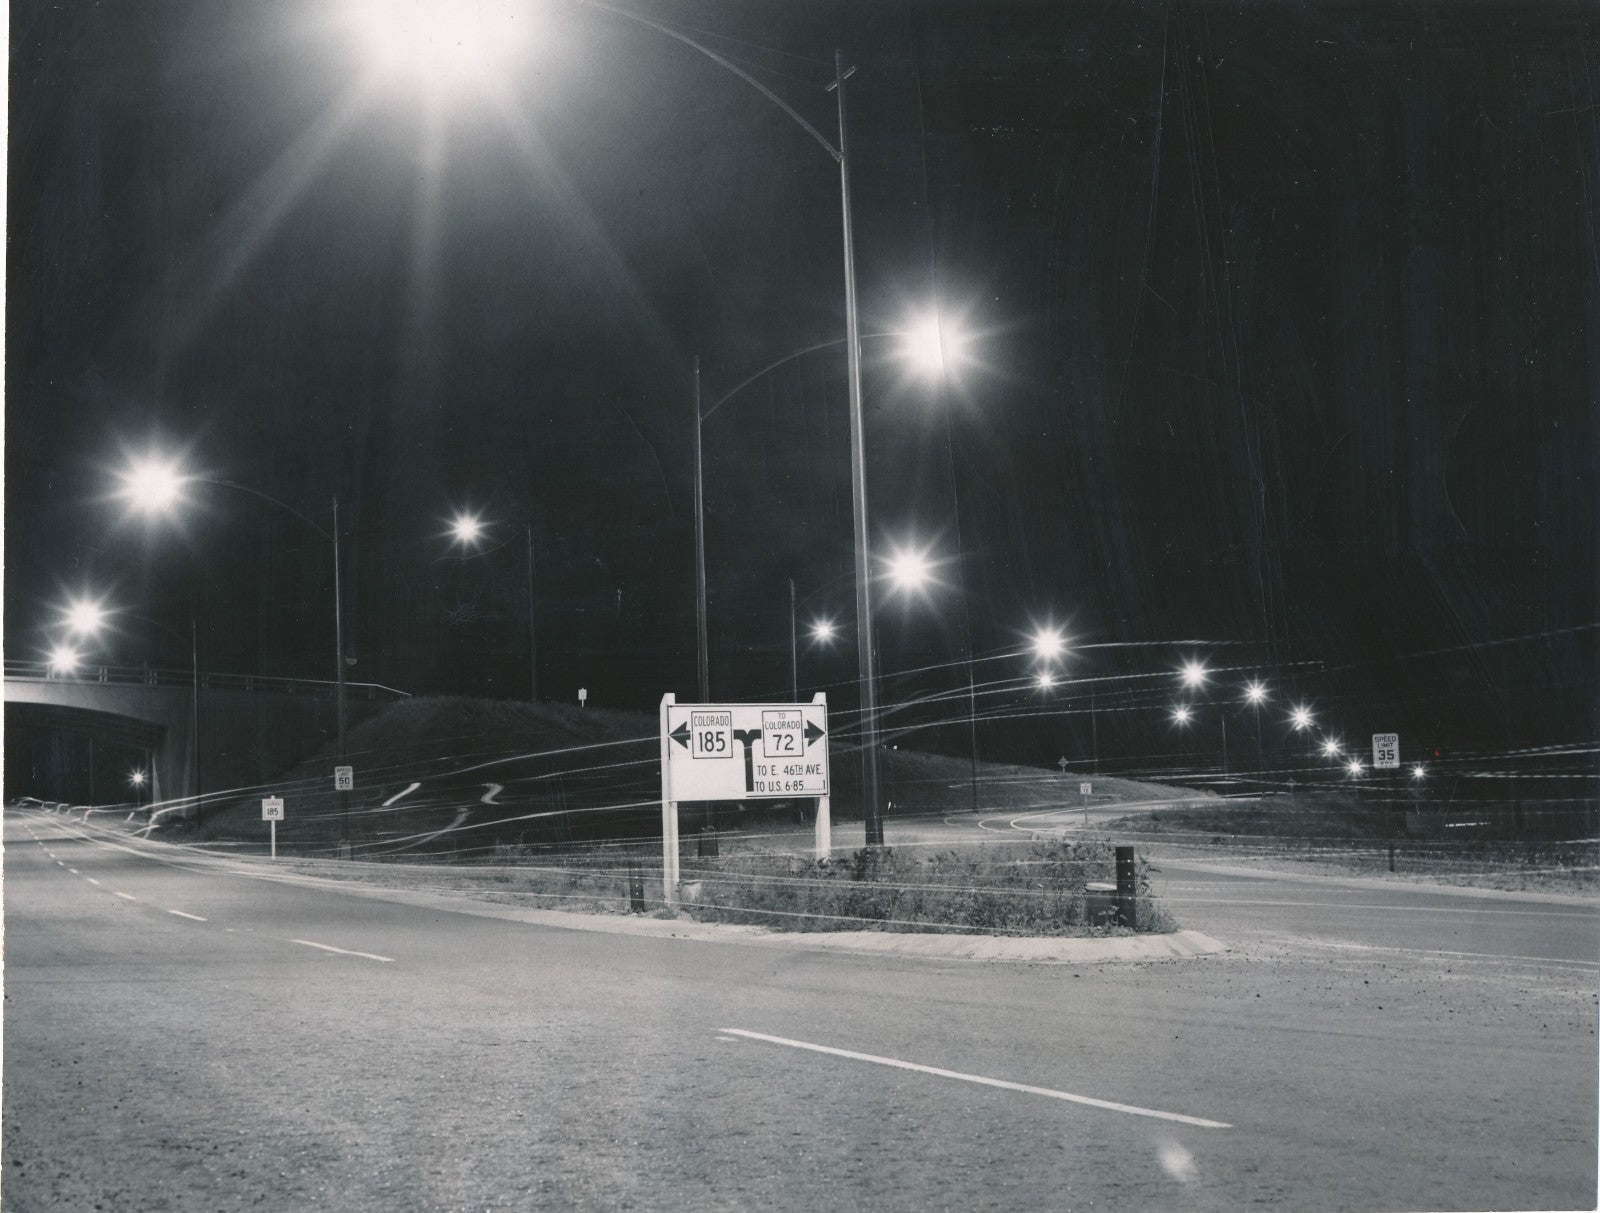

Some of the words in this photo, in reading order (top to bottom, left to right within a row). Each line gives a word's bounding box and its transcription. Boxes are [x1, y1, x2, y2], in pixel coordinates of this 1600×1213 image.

[694, 715, 729, 727] COLORADO
[778, 712, 786, 720] TO
[764, 720, 800, 730] COLORADO
[698, 731, 726, 753] 185
[772, 734, 794, 751] 72
[1374, 735, 1397, 743] SPEED
[1378, 749, 1395, 761] 35
[757, 765, 767, 776] TO
[771, 765, 778, 776] E.
[783, 764, 804, 776] 46TH
[805, 763, 824, 775] AVE.
[338, 777, 350, 785] 50
[754, 781, 766, 792] TO
[768, 780, 783, 792] U.S.
[266, 807, 279, 816] 185
